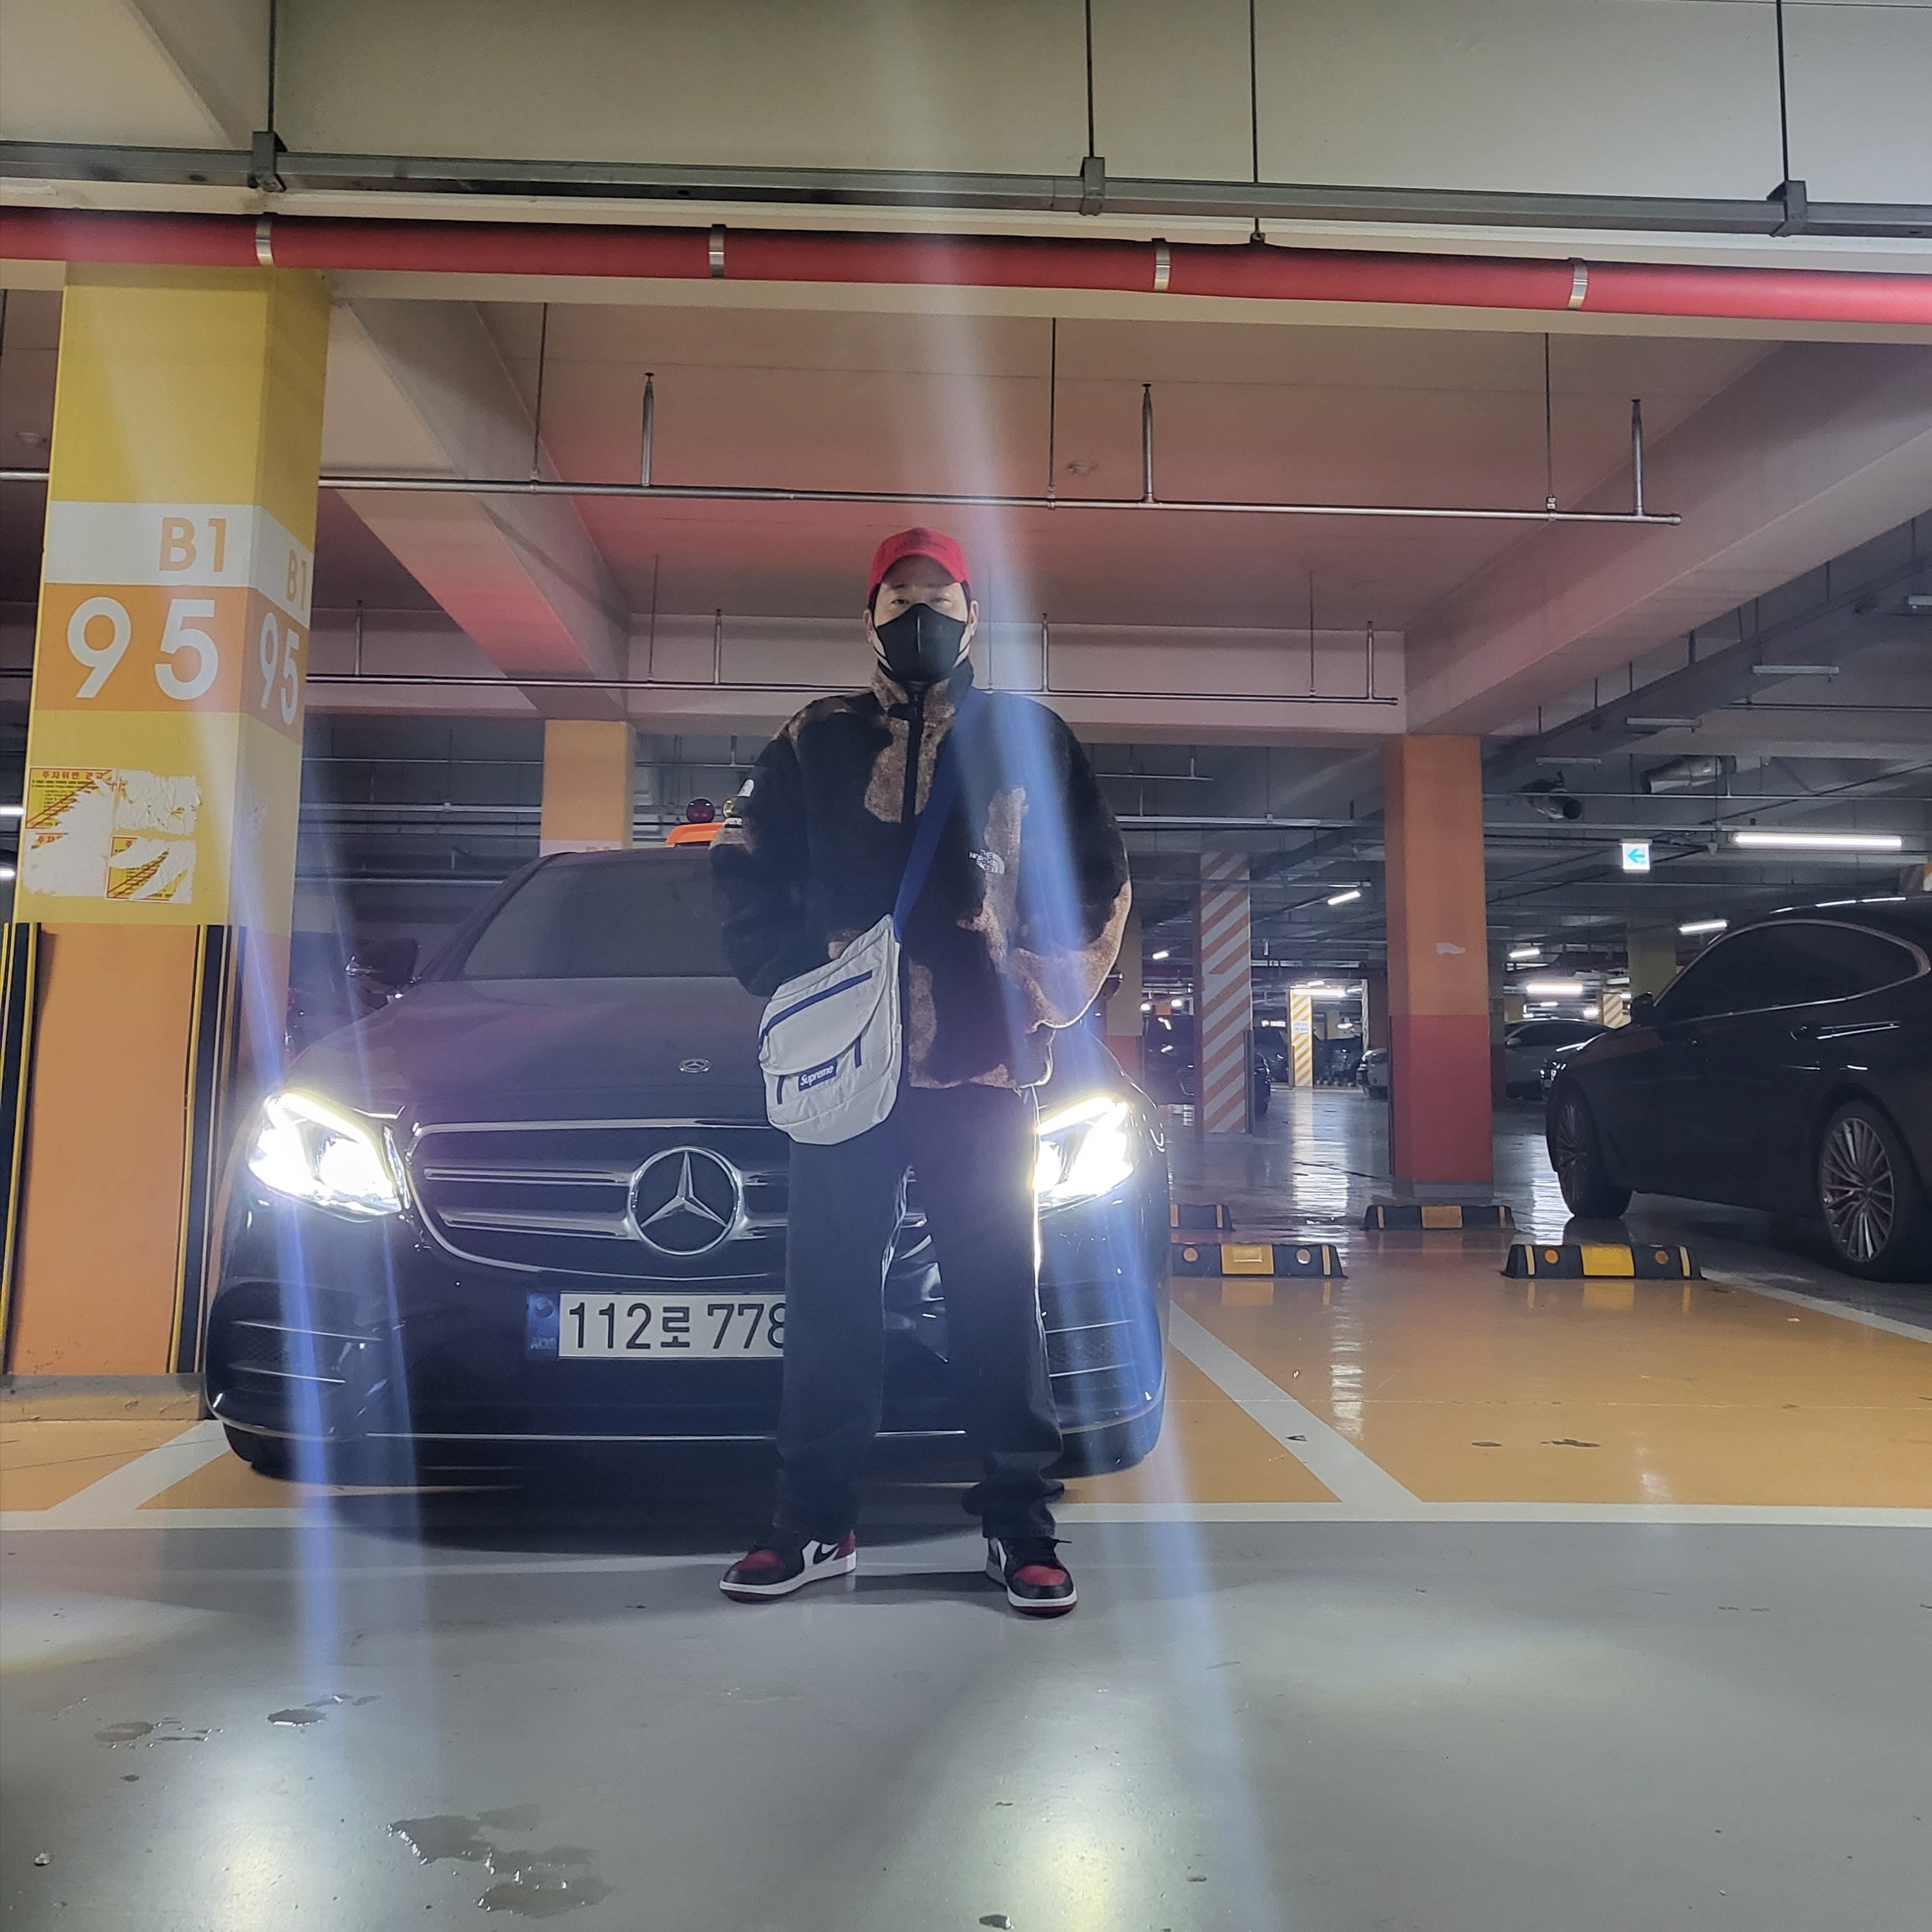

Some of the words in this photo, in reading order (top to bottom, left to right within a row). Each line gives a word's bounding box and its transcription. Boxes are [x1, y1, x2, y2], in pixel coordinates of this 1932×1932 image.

[159, 516, 227, 572] B1
[287, 547, 307, 611] B1
[67, 596, 219, 700] 95
[260, 611, 299, 725] 95
[800, 1065, 834, 1086] Supreme
